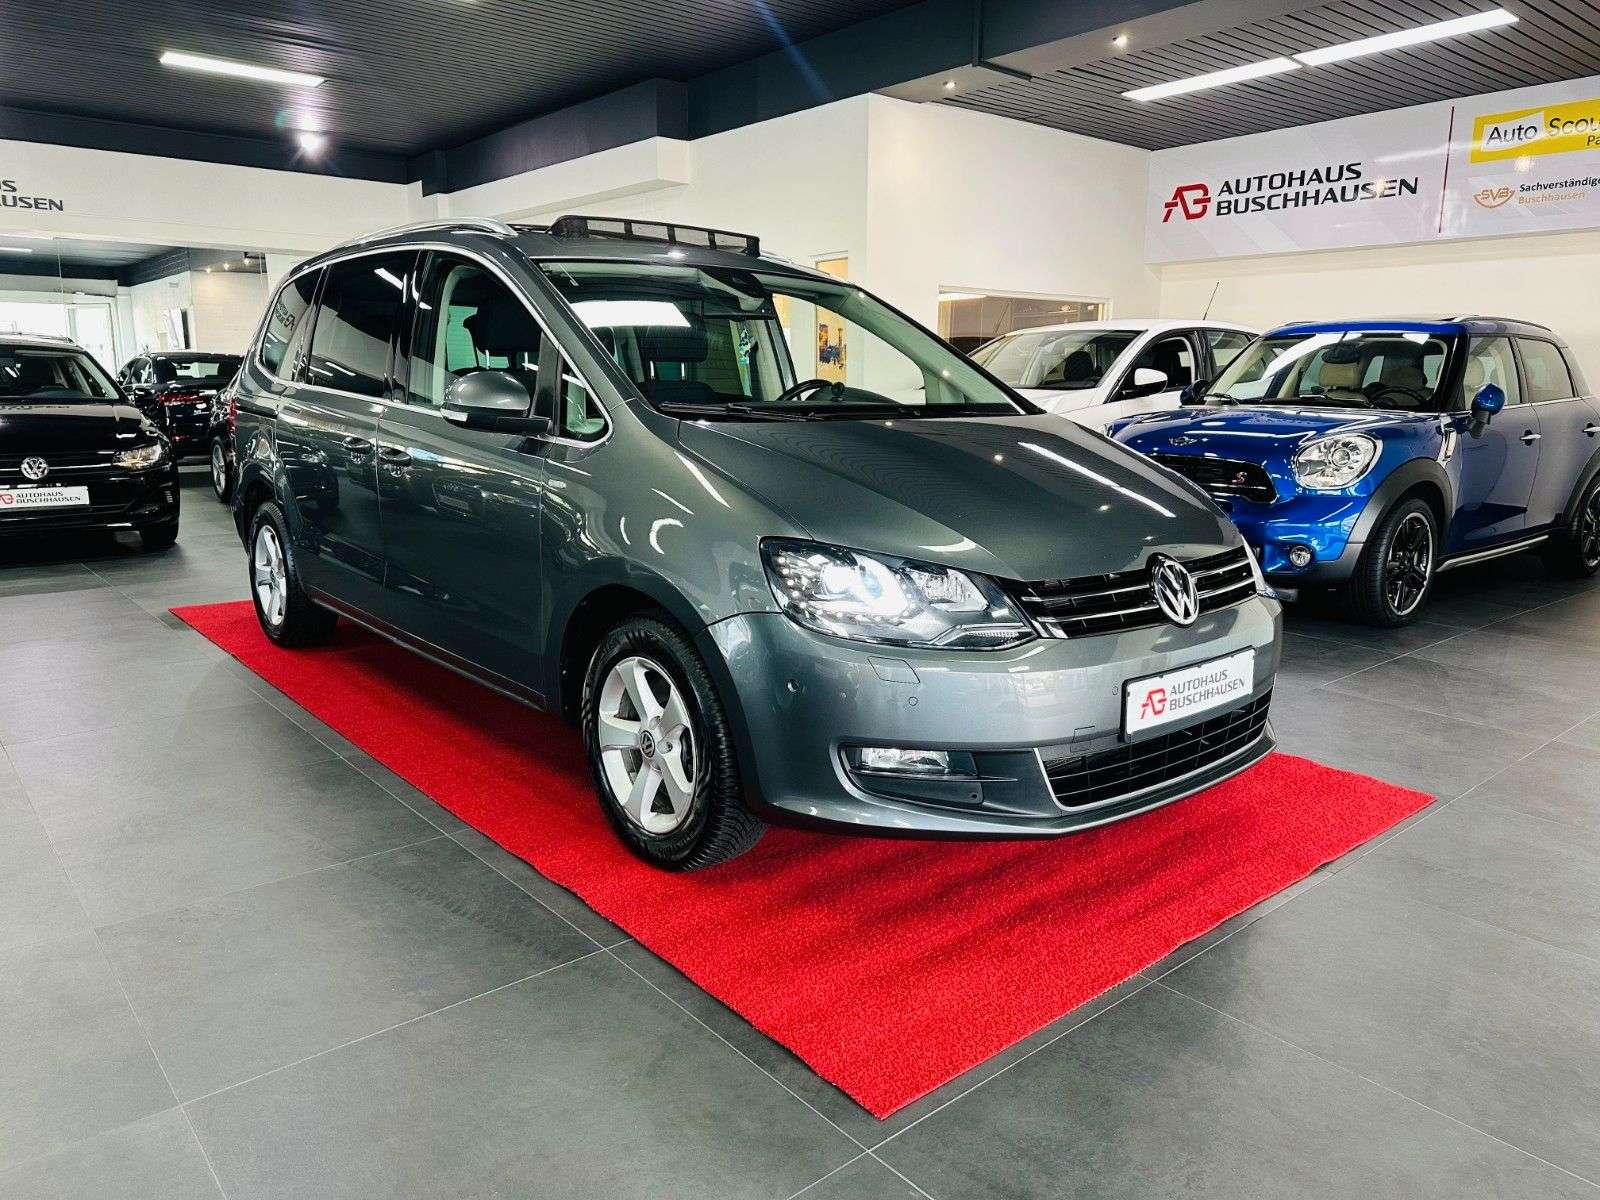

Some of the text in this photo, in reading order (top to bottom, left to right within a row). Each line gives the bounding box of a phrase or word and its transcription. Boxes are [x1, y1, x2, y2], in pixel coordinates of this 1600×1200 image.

[1486, 125, 1538, 145] Auto
[1218, 162, 1362, 197] AUTOHAUS
[0, 195, 64, 211] USEN
[1216, 177, 1418, 216] BUSCHHAUSEN
[1518, 191, 1585, 204] Buschhausen
[16, 491, 64, 499] AUTOHAUS
[16, 496, 81, 504] BUSCHHAUSEN
[1170, 669, 1229, 696] AUTOHAUS
[1169, 678, 1246, 711] BUSCHHAUSEN
